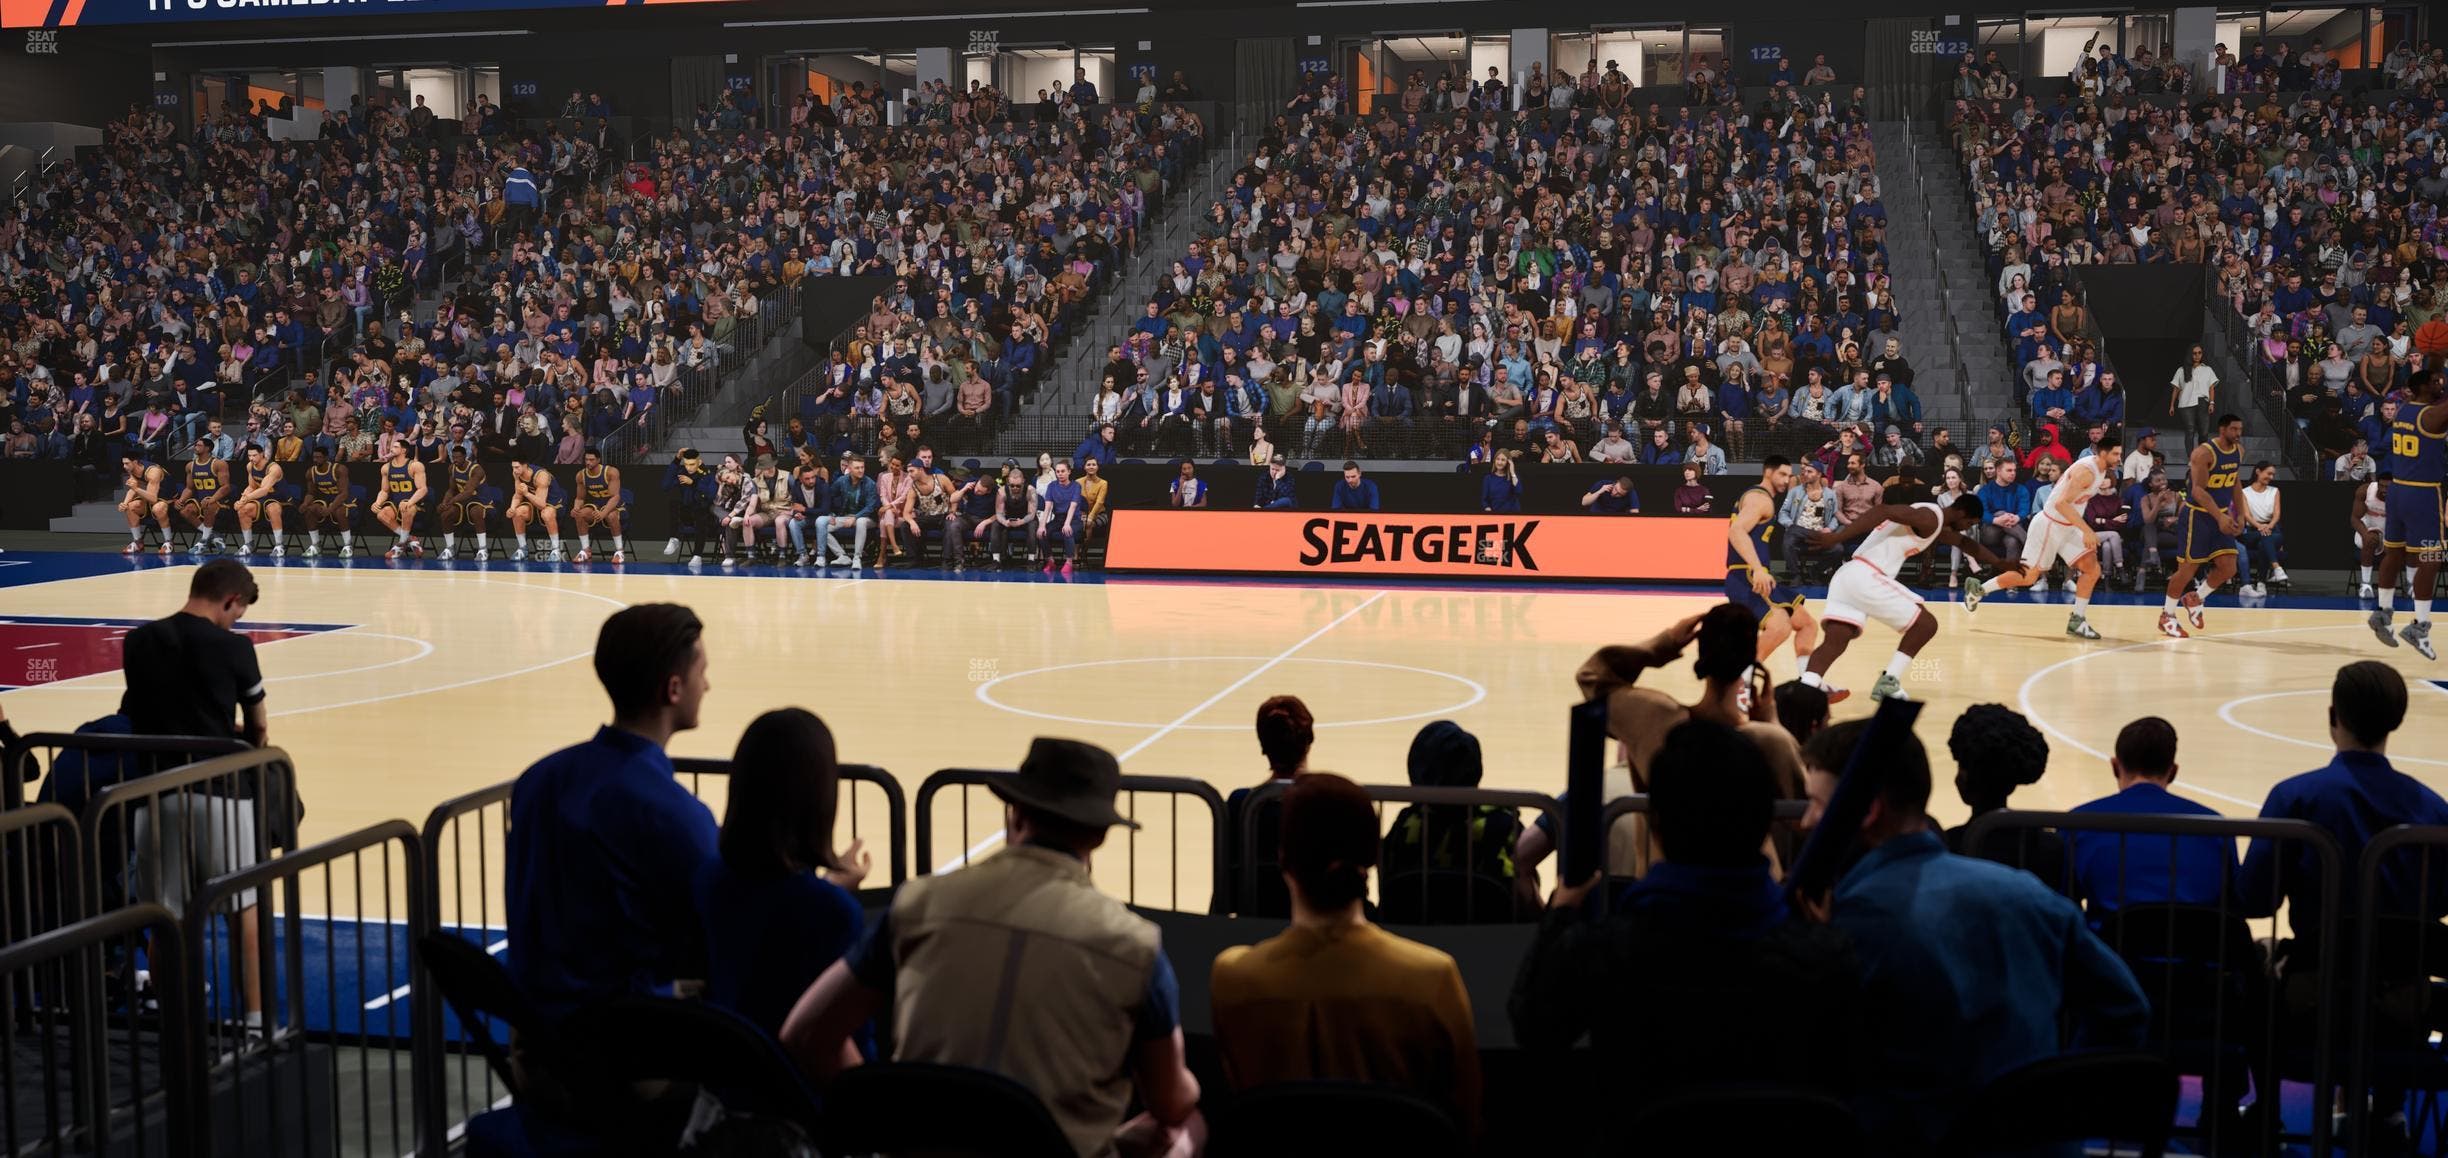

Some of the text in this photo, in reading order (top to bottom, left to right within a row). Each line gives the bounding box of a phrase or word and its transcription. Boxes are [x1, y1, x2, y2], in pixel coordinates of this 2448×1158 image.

[1751, 47, 1781, 59] 122
[1300, 61, 1328, 72] 122
[513, 84, 536, 95] 120
[156, 94, 178, 105] 120
[193, 478, 216, 490] 00
[389, 480, 413, 492] 00
[2208, 472, 2238, 488] 00
[1300, 518, 1540, 571] SEATGEEK
